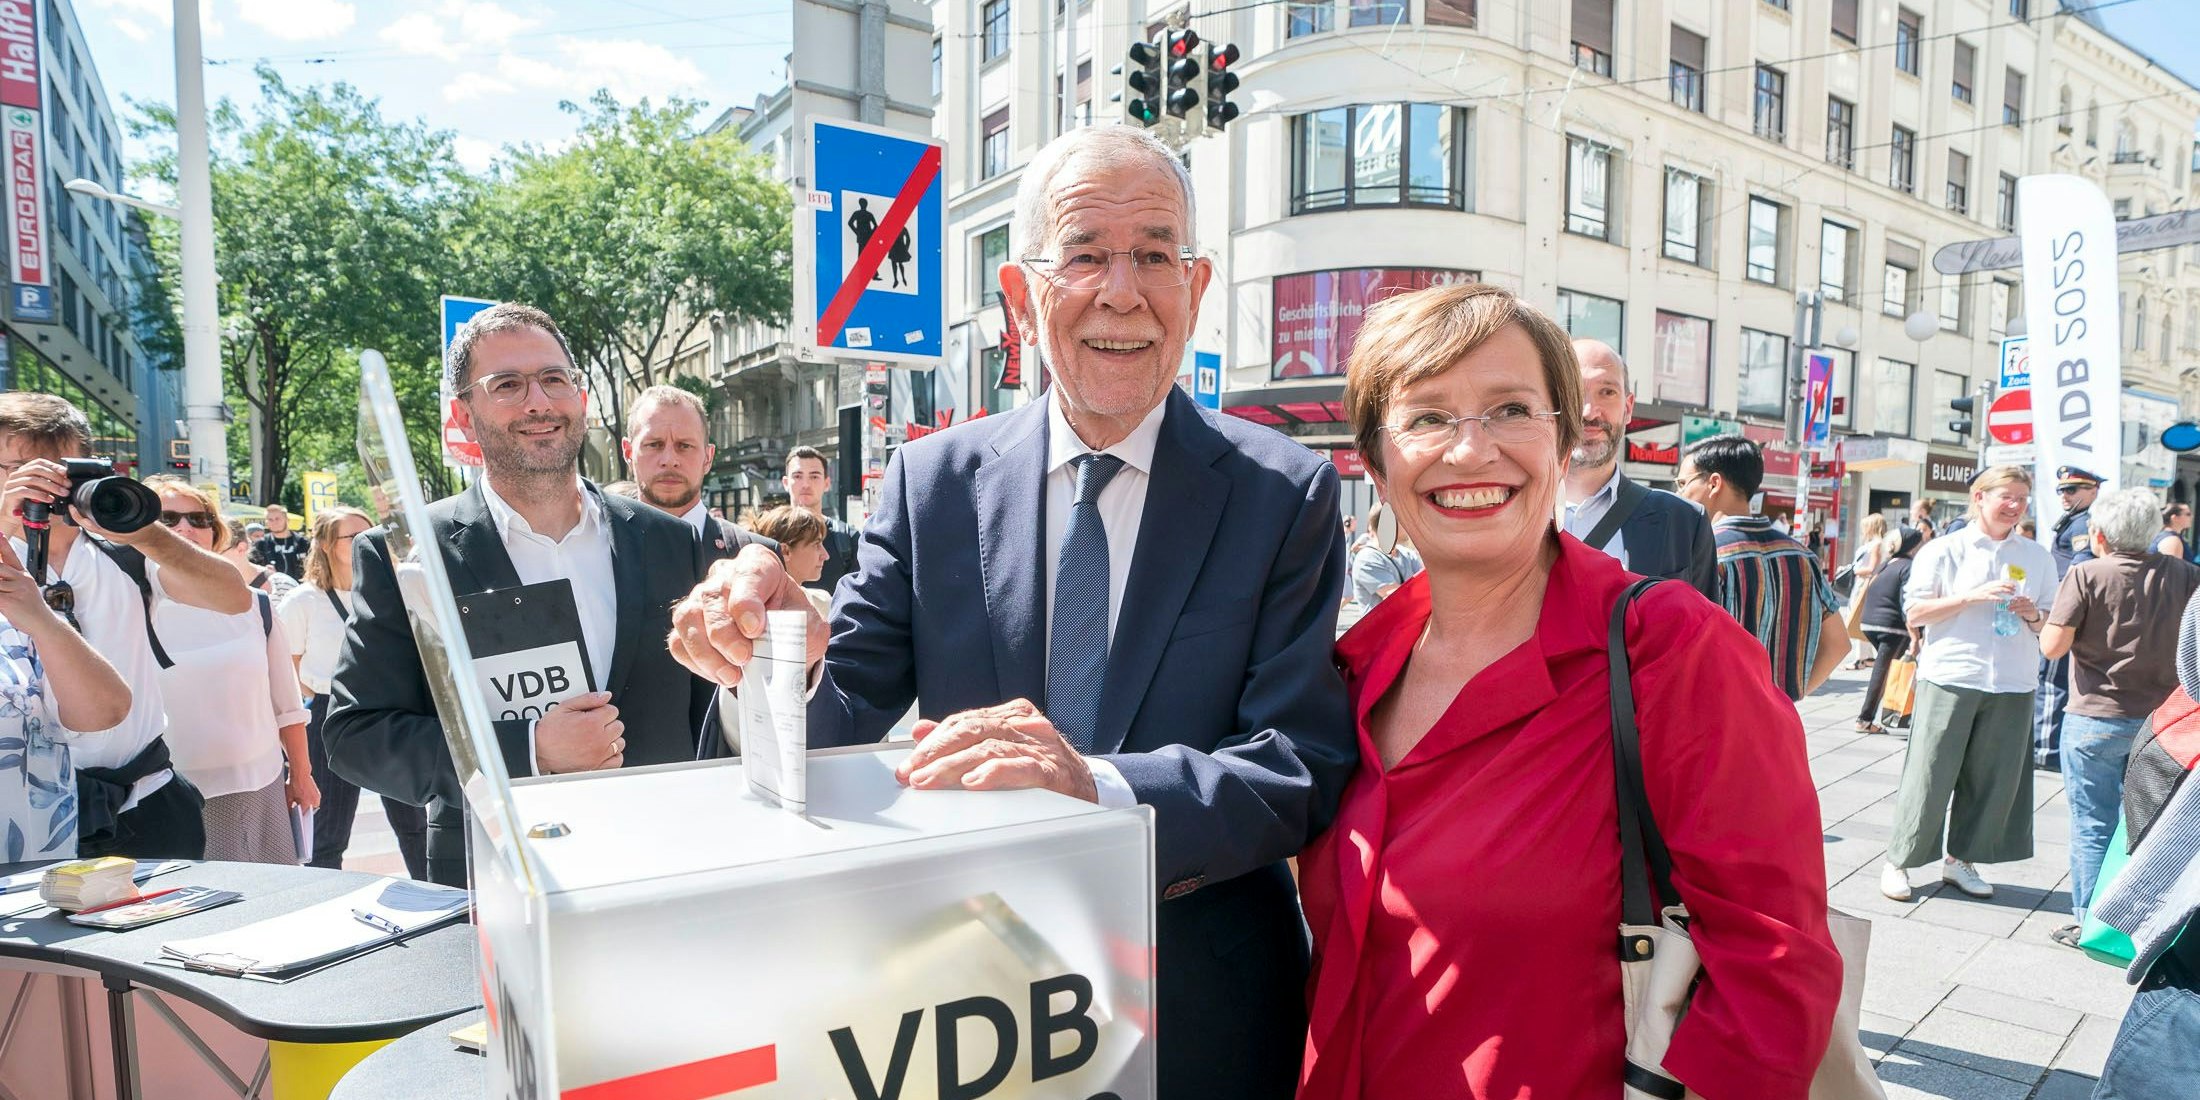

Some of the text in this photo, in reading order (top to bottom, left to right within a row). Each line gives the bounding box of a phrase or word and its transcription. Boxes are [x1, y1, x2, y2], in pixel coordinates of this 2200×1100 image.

[0, 0, 37, 84] HalfP
[13, 132, 41, 270] EUROSPAR
[1278, 331, 1290, 344] zu
[490, 666, 570, 702] VDB
[828, 974, 1099, 1100] VDB
